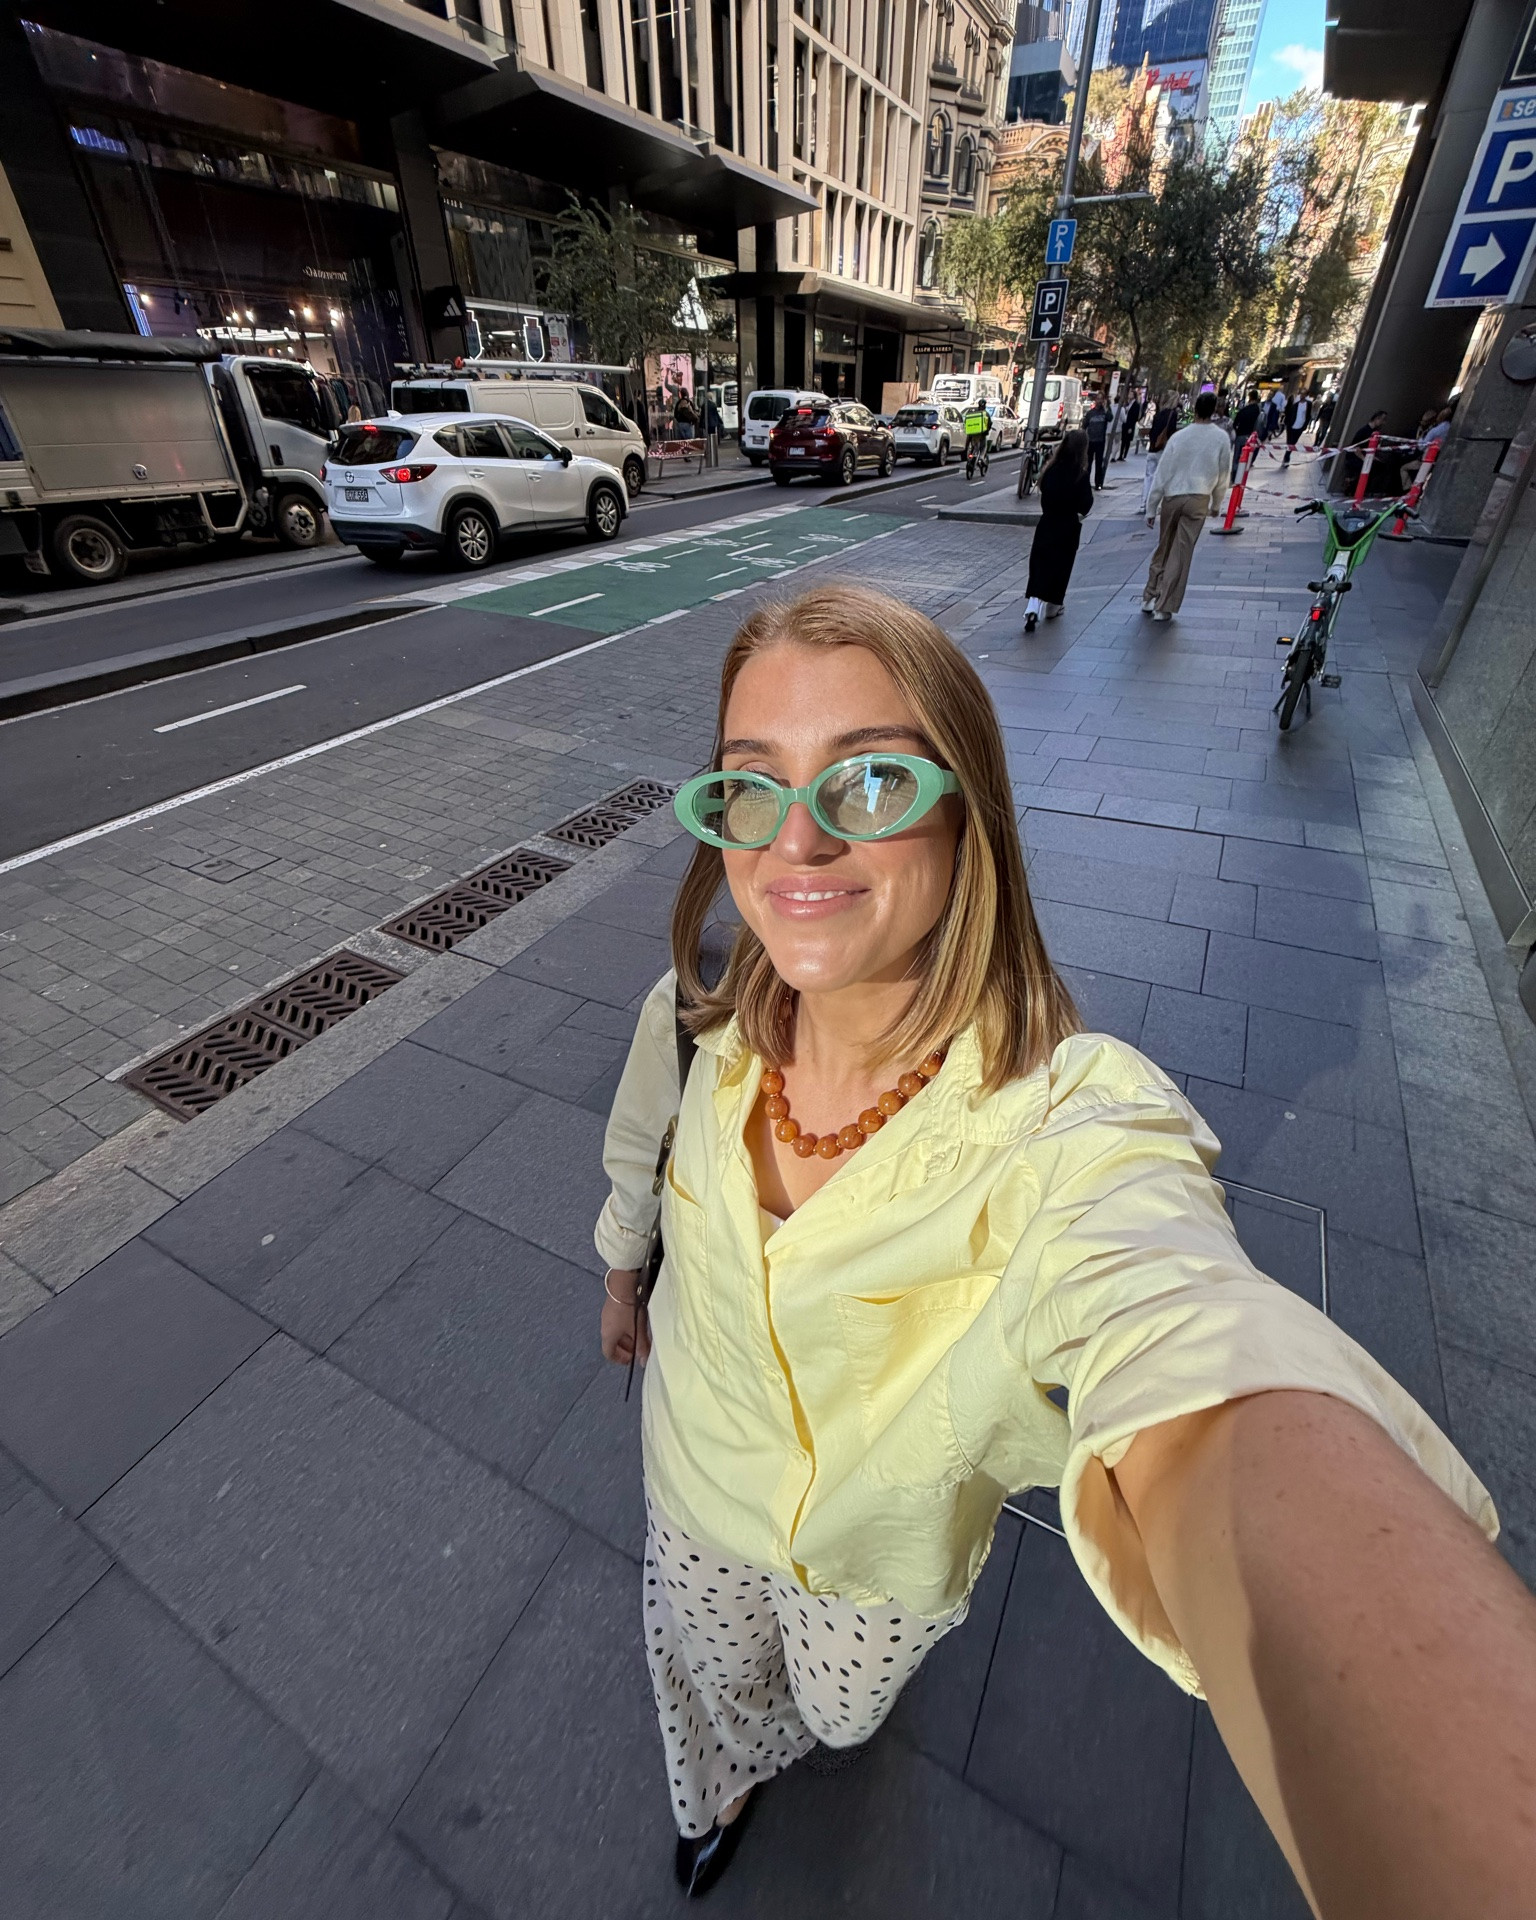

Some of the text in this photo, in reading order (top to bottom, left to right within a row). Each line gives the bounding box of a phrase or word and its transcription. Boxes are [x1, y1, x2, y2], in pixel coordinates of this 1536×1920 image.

[1487, 139, 1536, 204] P
[1055, 224, 1069, 242] P
[1044, 292, 1057, 310] P
